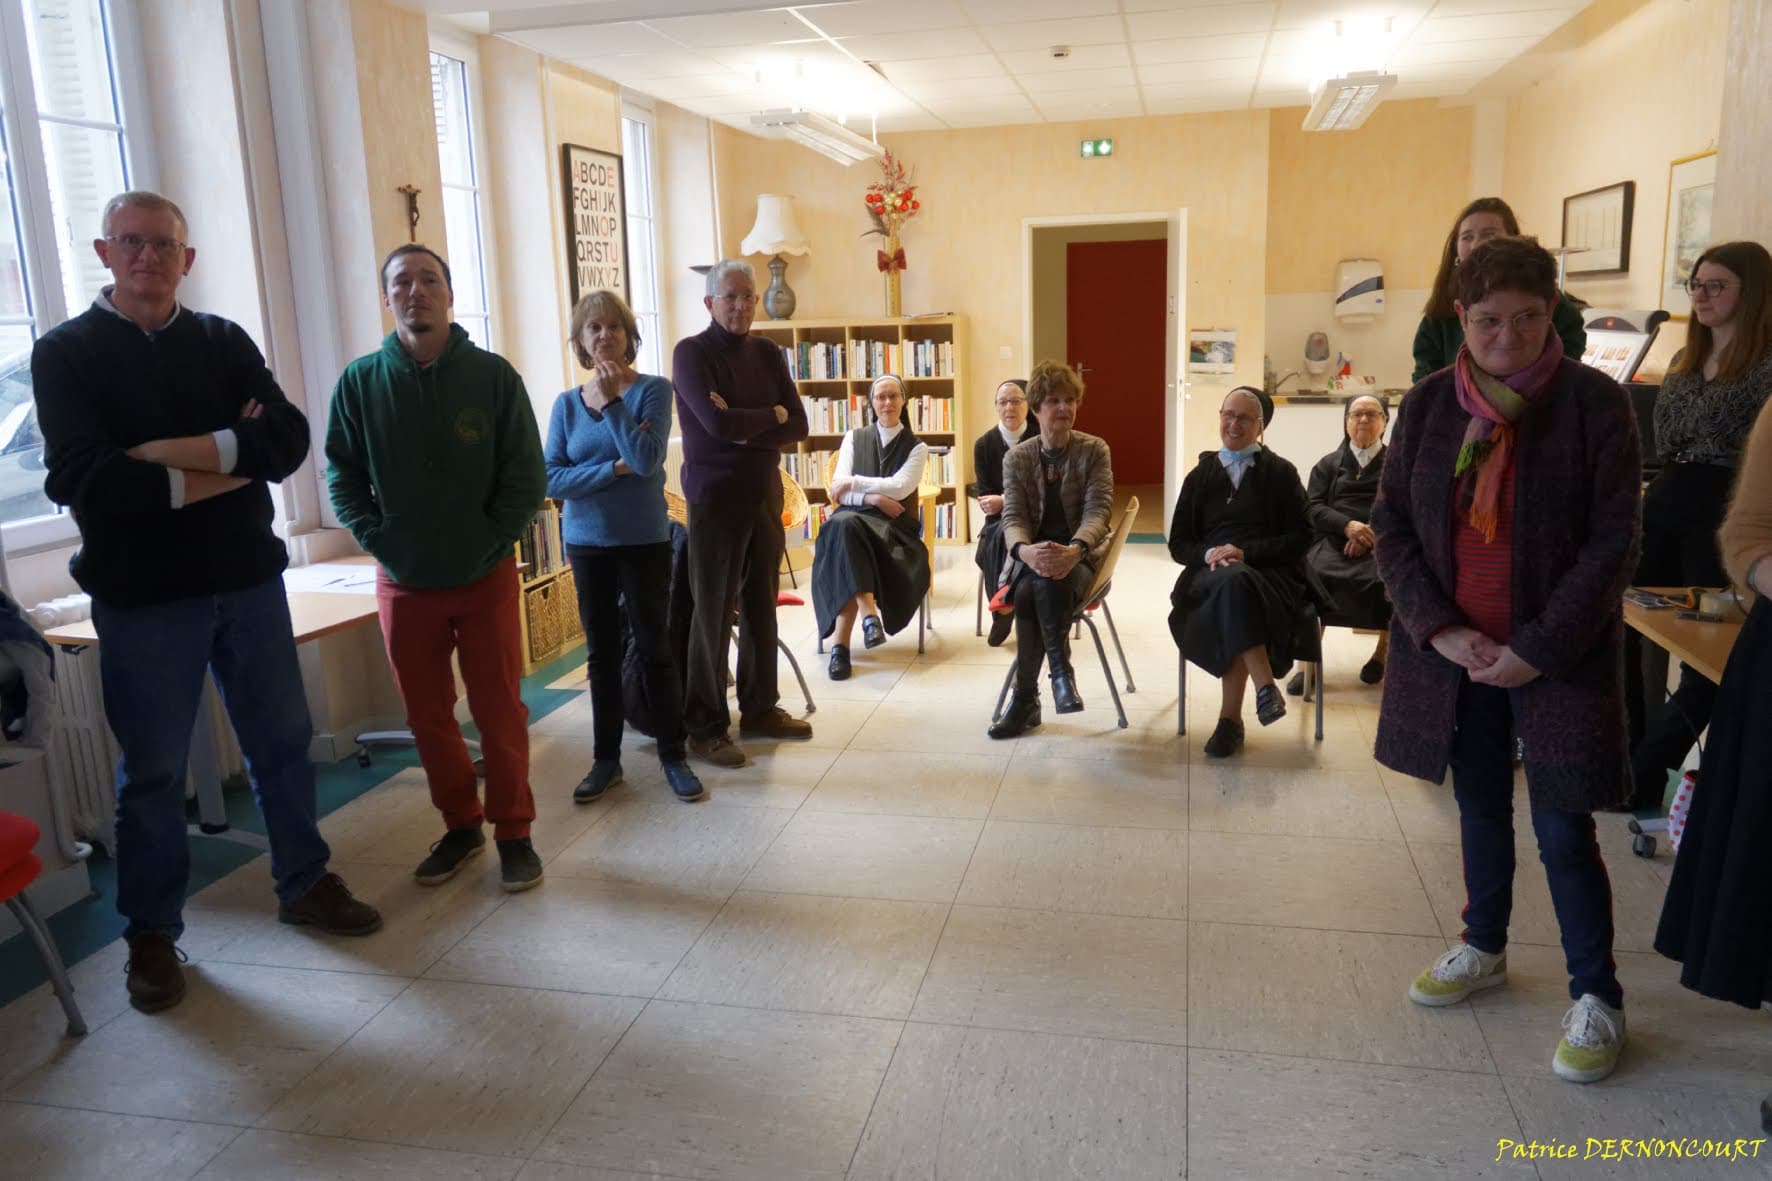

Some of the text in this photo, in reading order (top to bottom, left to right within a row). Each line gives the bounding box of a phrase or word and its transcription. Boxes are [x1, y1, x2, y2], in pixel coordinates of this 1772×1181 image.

[573, 160, 615, 188] ABCDE
[573, 187, 616, 213] FGHIJK
[574, 214, 617, 238] LMNOP
[577, 240, 618, 263] QRSTU
[578, 265, 620, 287] VWXYZ
